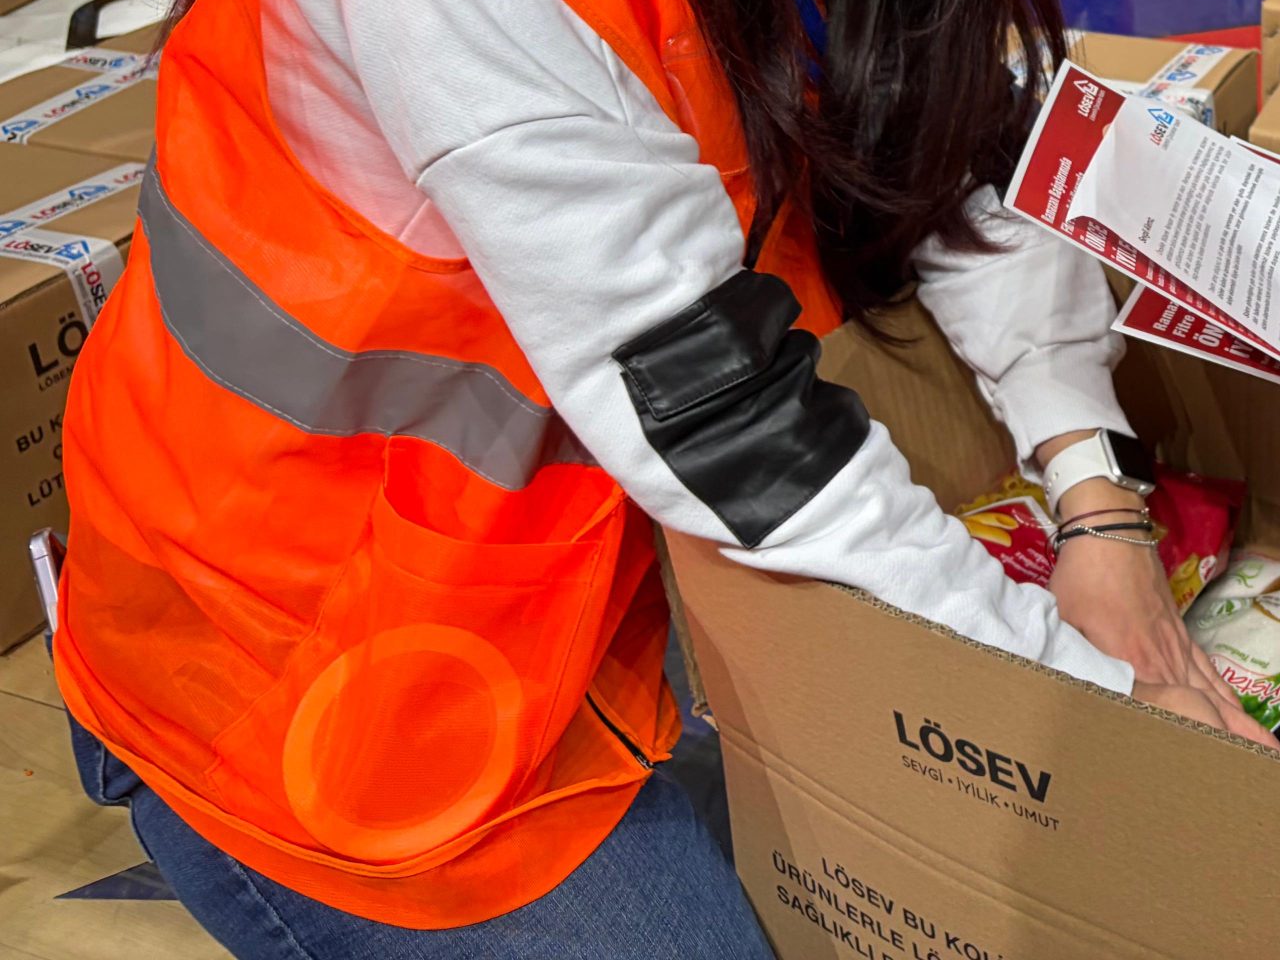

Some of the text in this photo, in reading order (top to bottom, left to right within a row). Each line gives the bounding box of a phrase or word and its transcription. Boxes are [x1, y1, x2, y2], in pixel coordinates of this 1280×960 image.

[1077, 92, 1095, 117] LÖSEV
[80, 261, 107, 309] LÖSE
[1153, 299, 1177, 332] Ramaz
[1172, 314, 1194, 338] Fitre
[1193, 322, 1225, 348] ÖN
[16, 426, 44, 454] BU
[27, 471, 63, 508] LÜT
[892, 709, 1052, 804] LÖSEV
[901, 755, 1060, 832] SEVGİ İYİLİK UMUT
[772, 850, 905, 952] ÜRÜNLERLE
[821, 856, 895, 916] LÖSEV
[902, 907, 936, 940] BU
[776, 884, 875, 960] SAĞLIKLI
